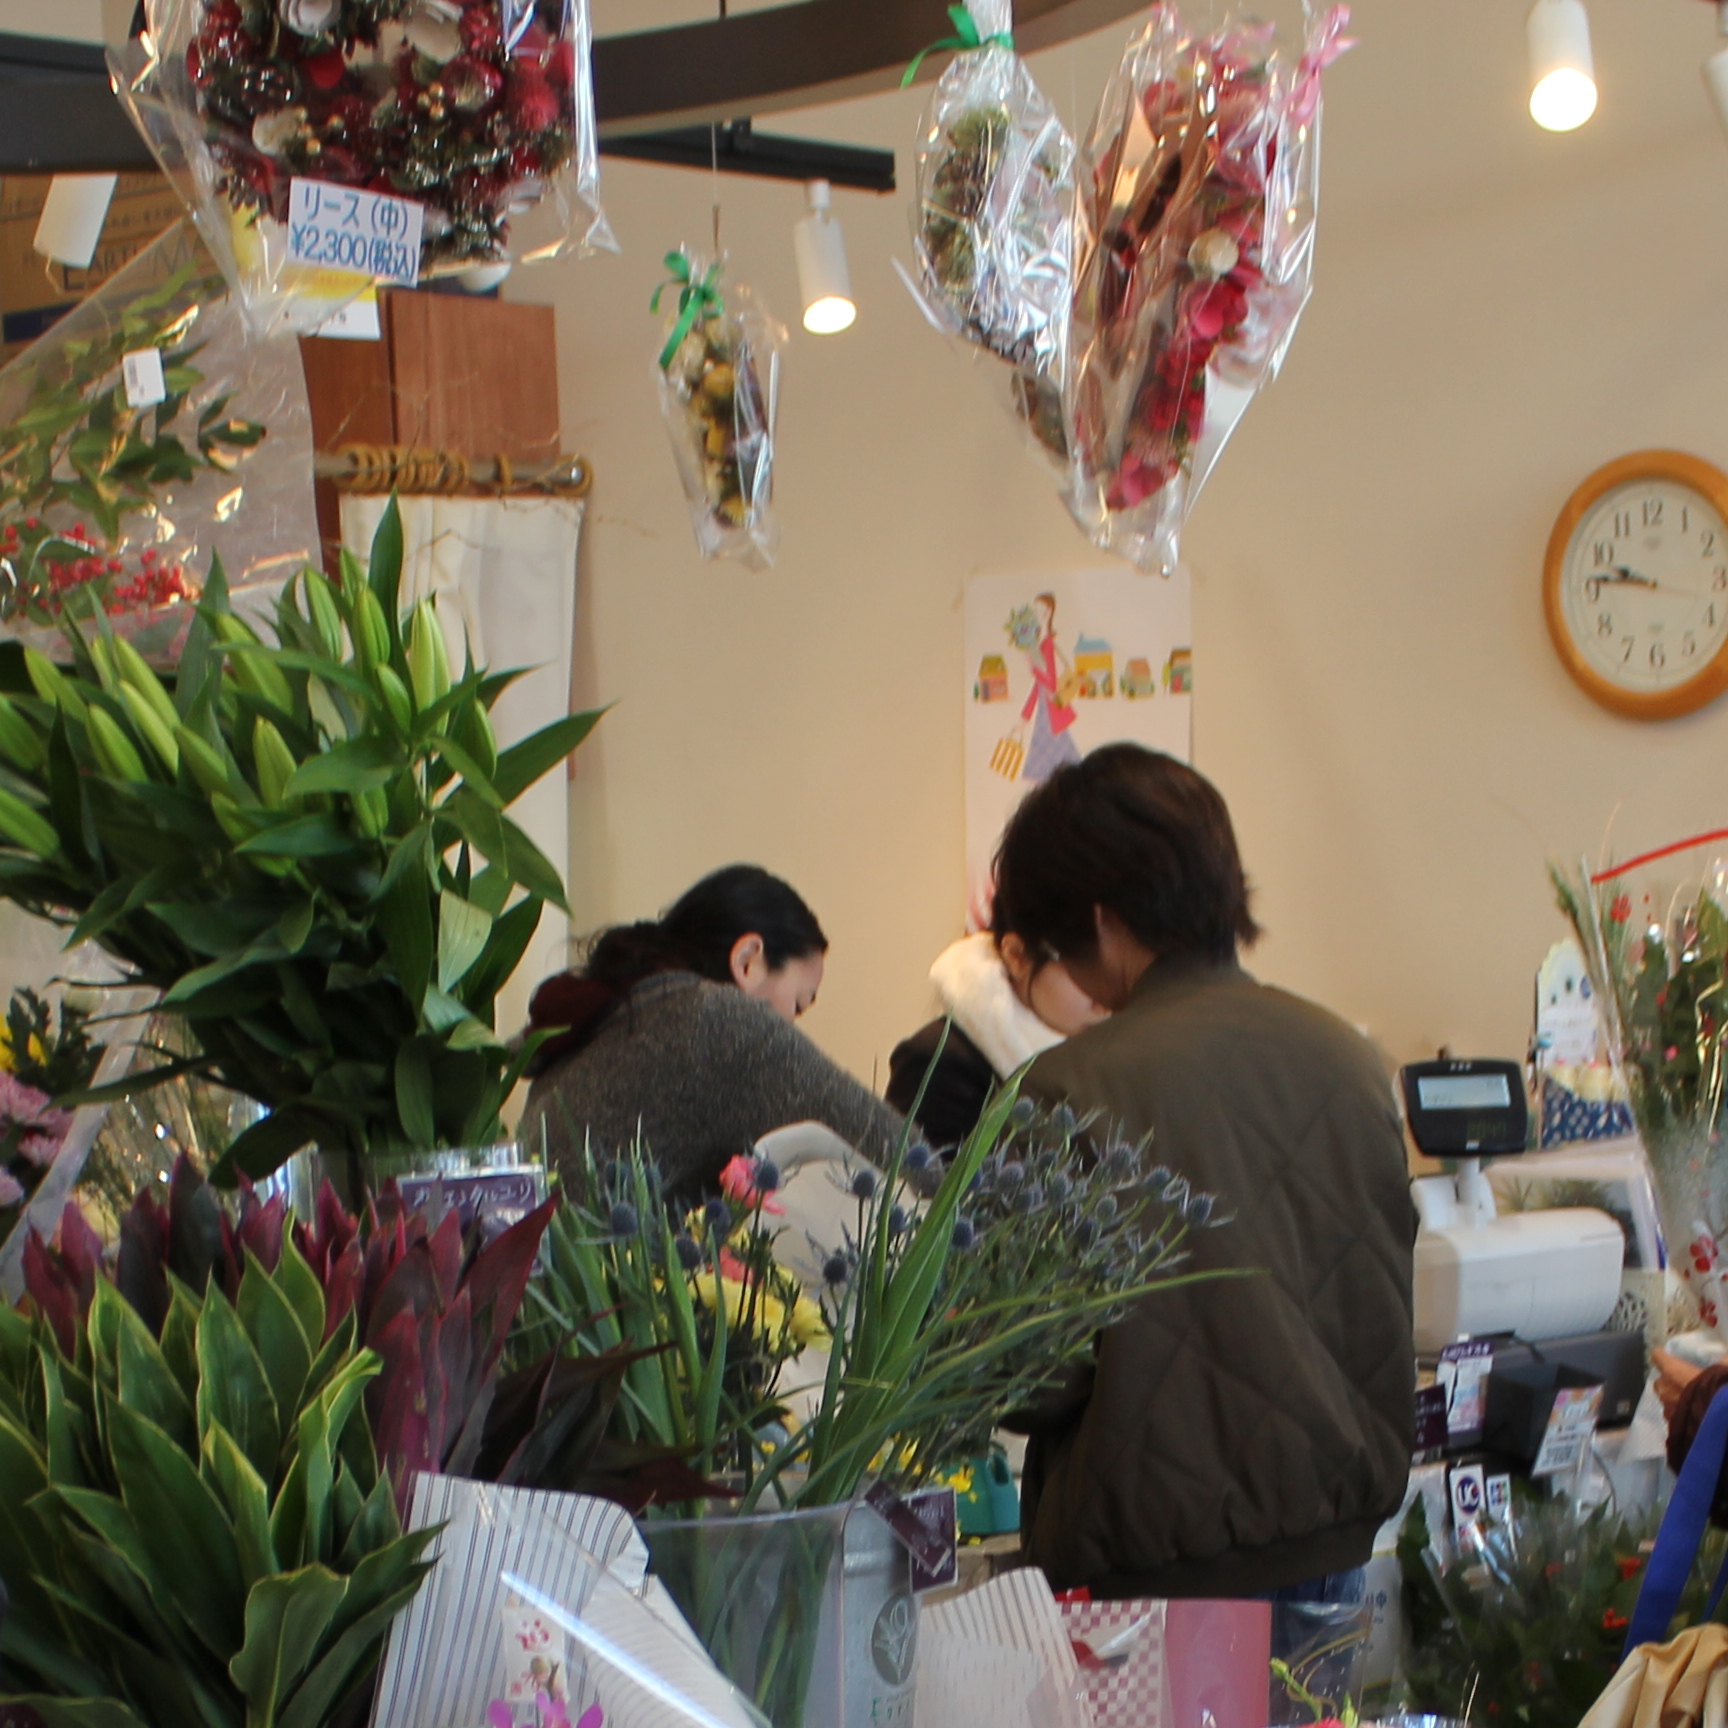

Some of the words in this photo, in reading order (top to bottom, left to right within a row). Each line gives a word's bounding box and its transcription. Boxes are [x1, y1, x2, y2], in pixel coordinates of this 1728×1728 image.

[304, 185, 408, 239] リース(中)
[291, 222, 416, 282] ¥2,300(税込)
[1613, 509, 1631, 540] 11
[1641, 498, 1664, 528] 12
[1680, 505, 1689, 534] 1
[1593, 540, 1614, 568] 10
[1700, 529, 1715, 559] 2
[1585, 576, 1601, 602] 9
[1712, 566, 1728, 593] 3
[1597, 612, 1614, 638] 8
[1703, 601, 1715, 629] 4
[1621, 634, 1635, 664] 7
[1649, 642, 1666, 669] 6
[1682, 629, 1696, 657] 5
